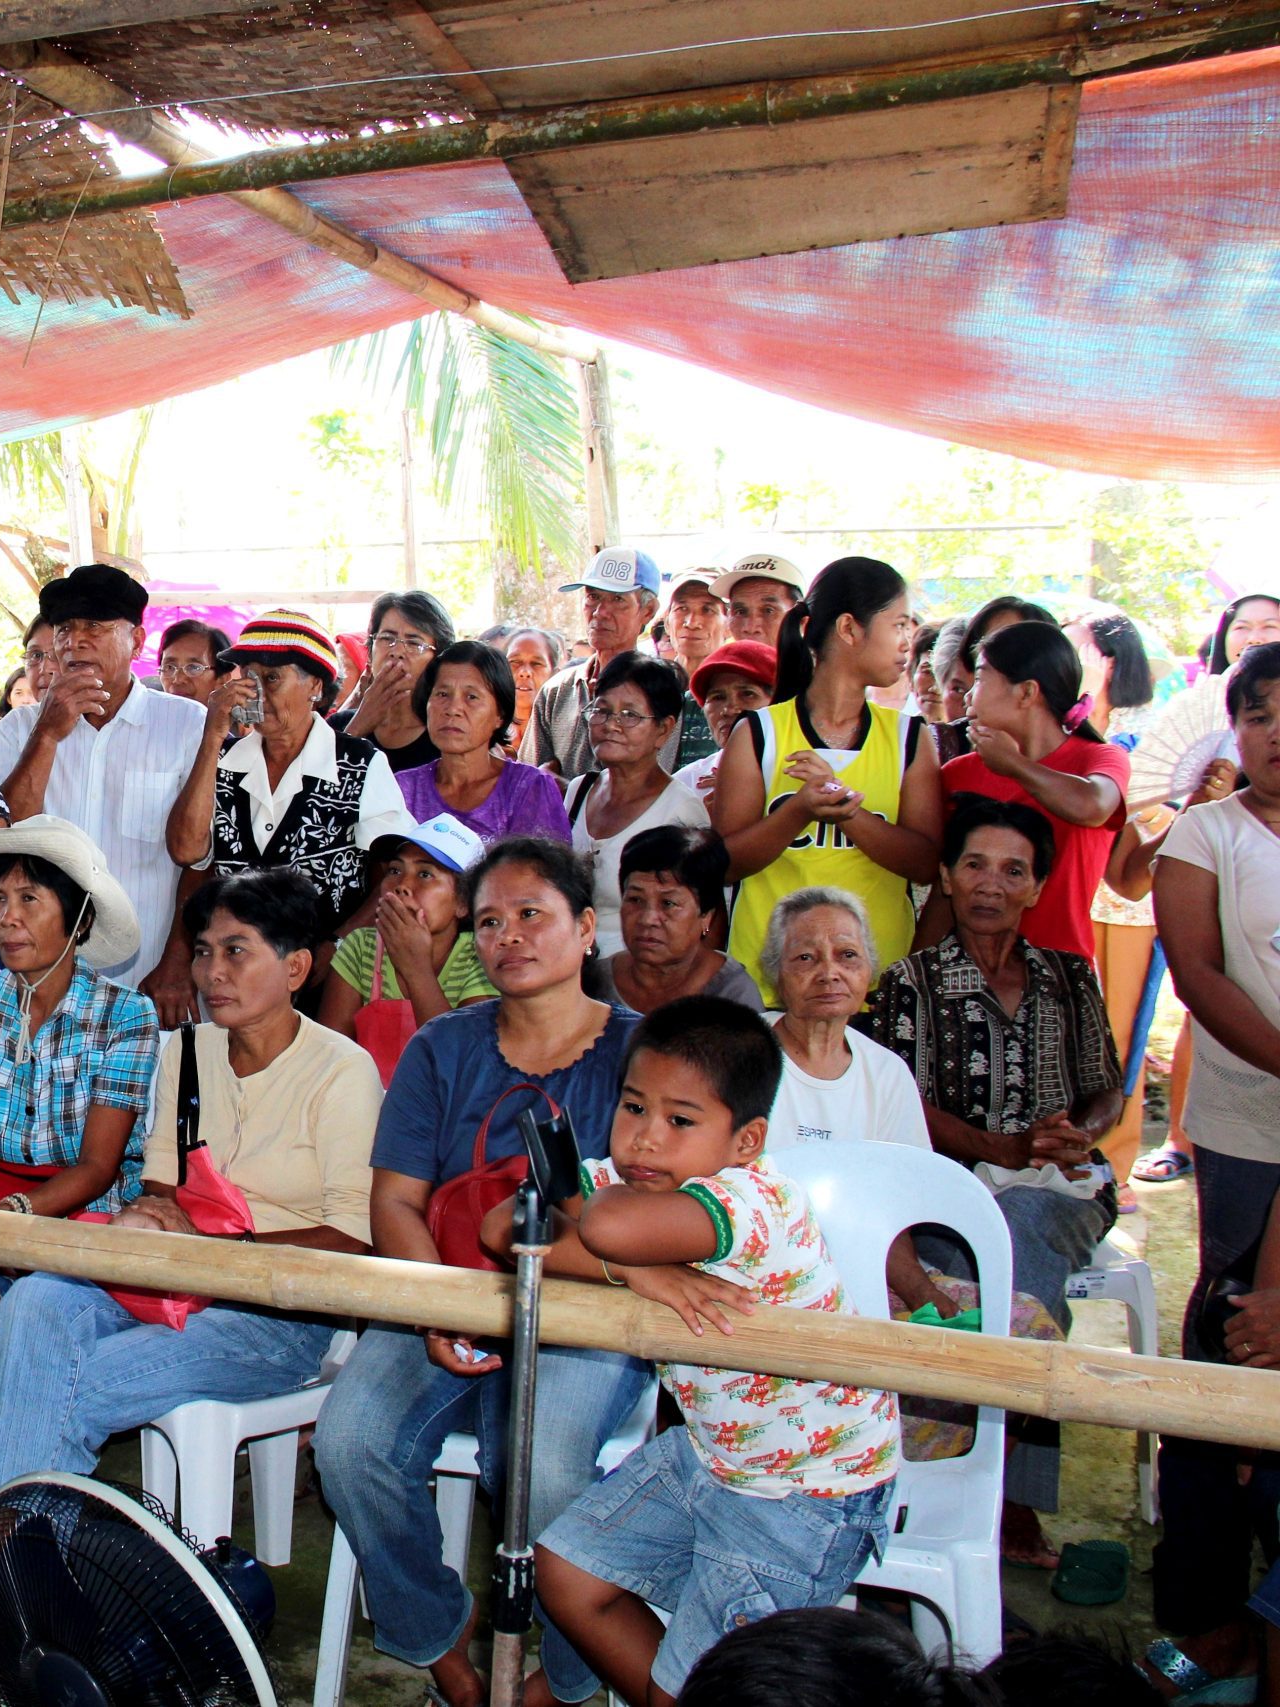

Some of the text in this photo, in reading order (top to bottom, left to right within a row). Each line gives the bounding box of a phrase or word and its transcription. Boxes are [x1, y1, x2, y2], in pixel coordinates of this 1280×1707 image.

[601, 558, 632, 582] 08
[449, 830, 470, 846] Globe
[797, 1124, 832, 1140] ESPRIT
[752, 1383, 771, 1393] THE
